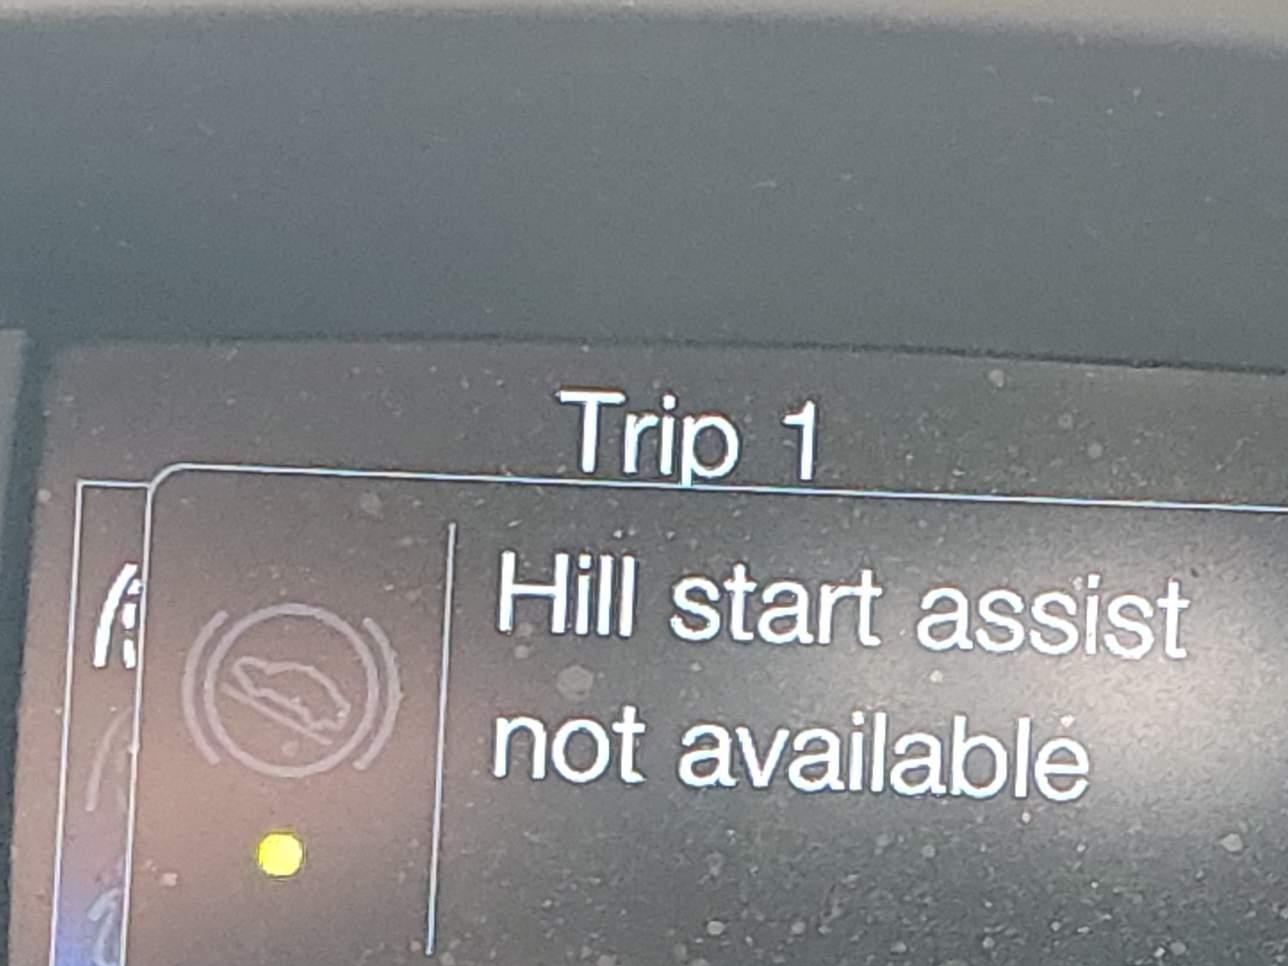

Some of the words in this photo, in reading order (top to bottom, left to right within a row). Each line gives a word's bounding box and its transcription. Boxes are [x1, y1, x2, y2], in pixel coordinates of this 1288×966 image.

[558, 388, 740, 486] Trip
[783, 400, 818, 481] 1
[498, 551, 637, 638] Hill
[669, 562, 884, 647] start
[917, 575, 1191, 660] assist
[492, 705, 646, 783] not
[678, 710, 1091, 801] available
